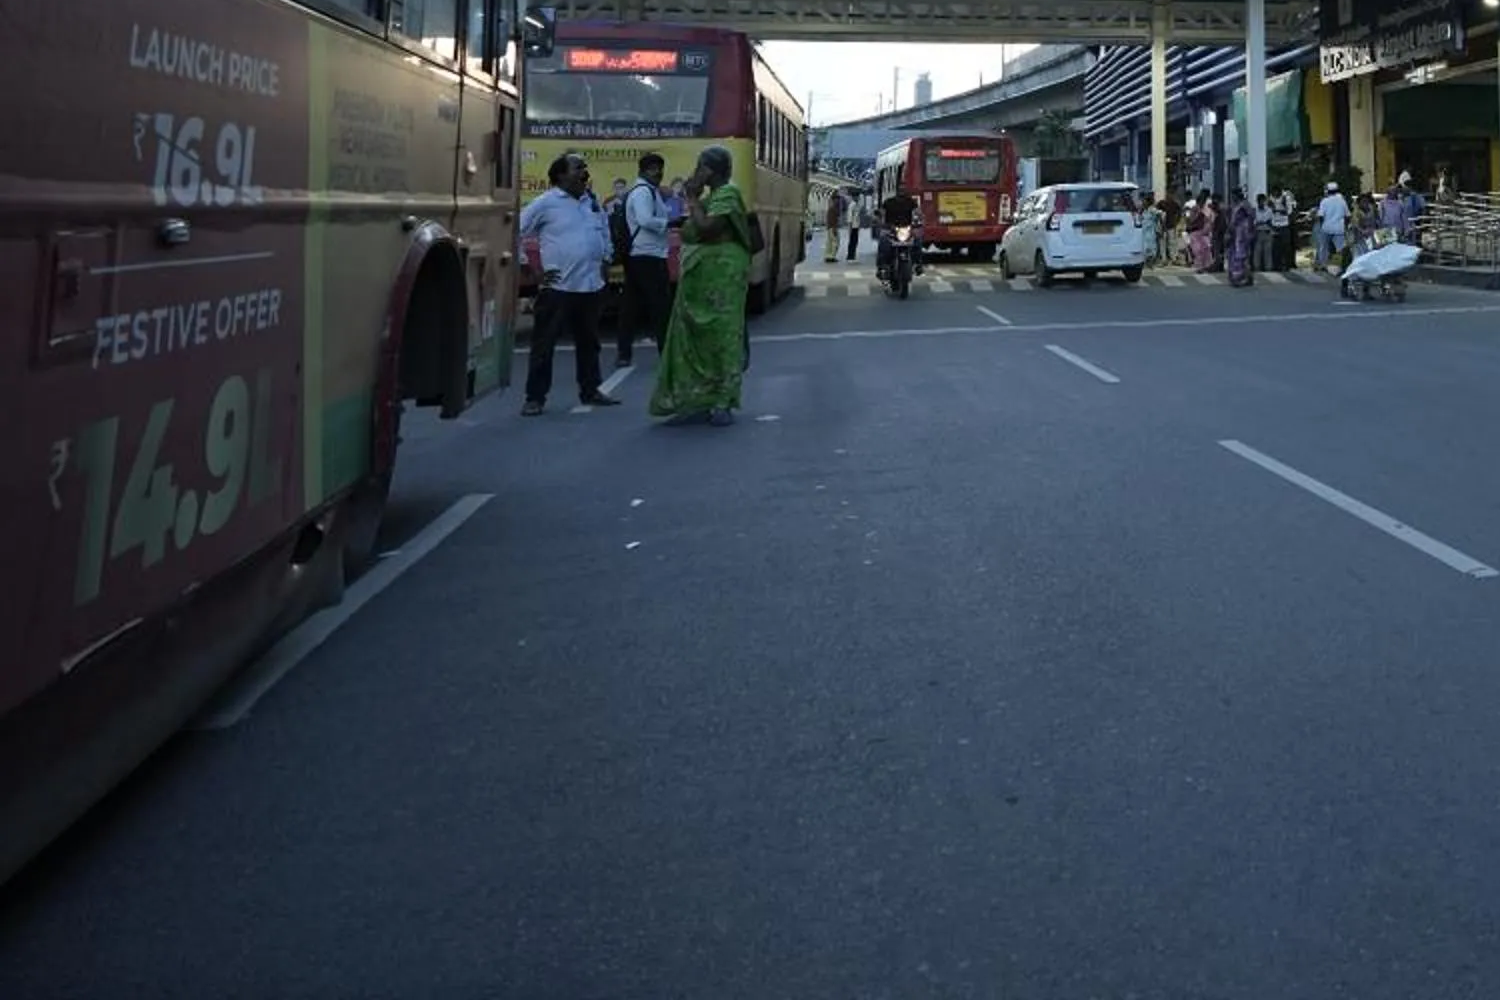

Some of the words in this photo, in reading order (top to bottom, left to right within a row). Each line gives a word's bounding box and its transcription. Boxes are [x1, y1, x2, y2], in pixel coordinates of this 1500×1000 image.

[130, 23, 224, 86] LAUNCH
[229, 52, 280, 97] PRICE
[92, 300, 210, 369] FESTIVE
[215, 289, 282, 339] OFFER
